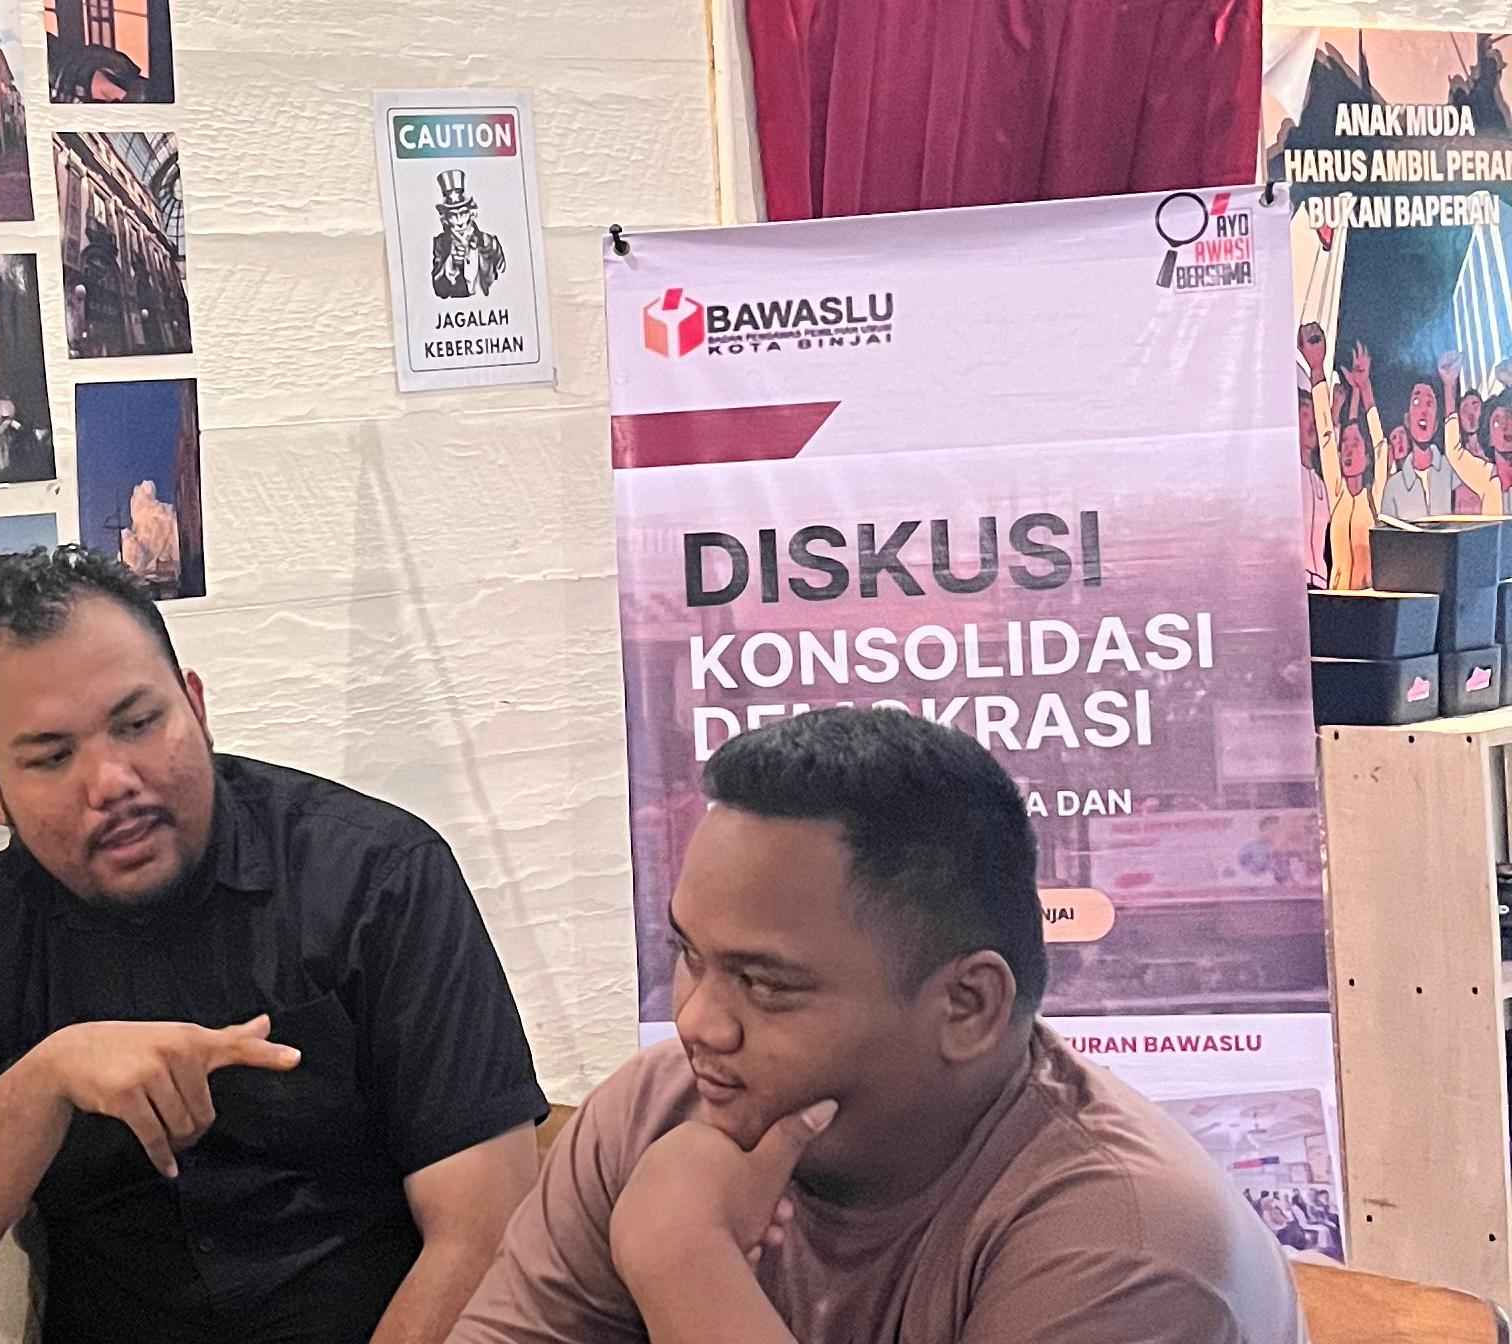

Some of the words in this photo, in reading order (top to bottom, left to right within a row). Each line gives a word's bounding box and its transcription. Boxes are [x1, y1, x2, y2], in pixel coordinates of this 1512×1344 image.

[1335, 103, 1404, 137] ANAK
[1406, 104, 1476, 137] MUDA
[399, 123, 512, 150] CAUTION
[1284, 149, 1368, 183] HARUS
[1369, 149, 1444, 182] AMBIL
[1216, 213, 1249, 238] AYO
[1308, 195, 1392, 228] BUKAN
[1395, 194, 1500, 227] BAPERAN
[1194, 237, 1250, 264] AWASI
[1176, 261, 1252, 290] BERSAMA
[435, 309, 510, 330] JAGALAH
[706, 292, 894, 334] BAWASLU
[424, 335, 524, 359] KEBERSIHAN
[708, 341, 782, 356] KOTA
[797, 333, 892, 350] BINJAI
[684, 510, 1102, 608] DISKUSI
[688, 612, 1214, 690] KONSOLIDASI
[1056, 788, 1133, 817] DAN
[1144, 1034, 1263, 1053] BAWASLU
